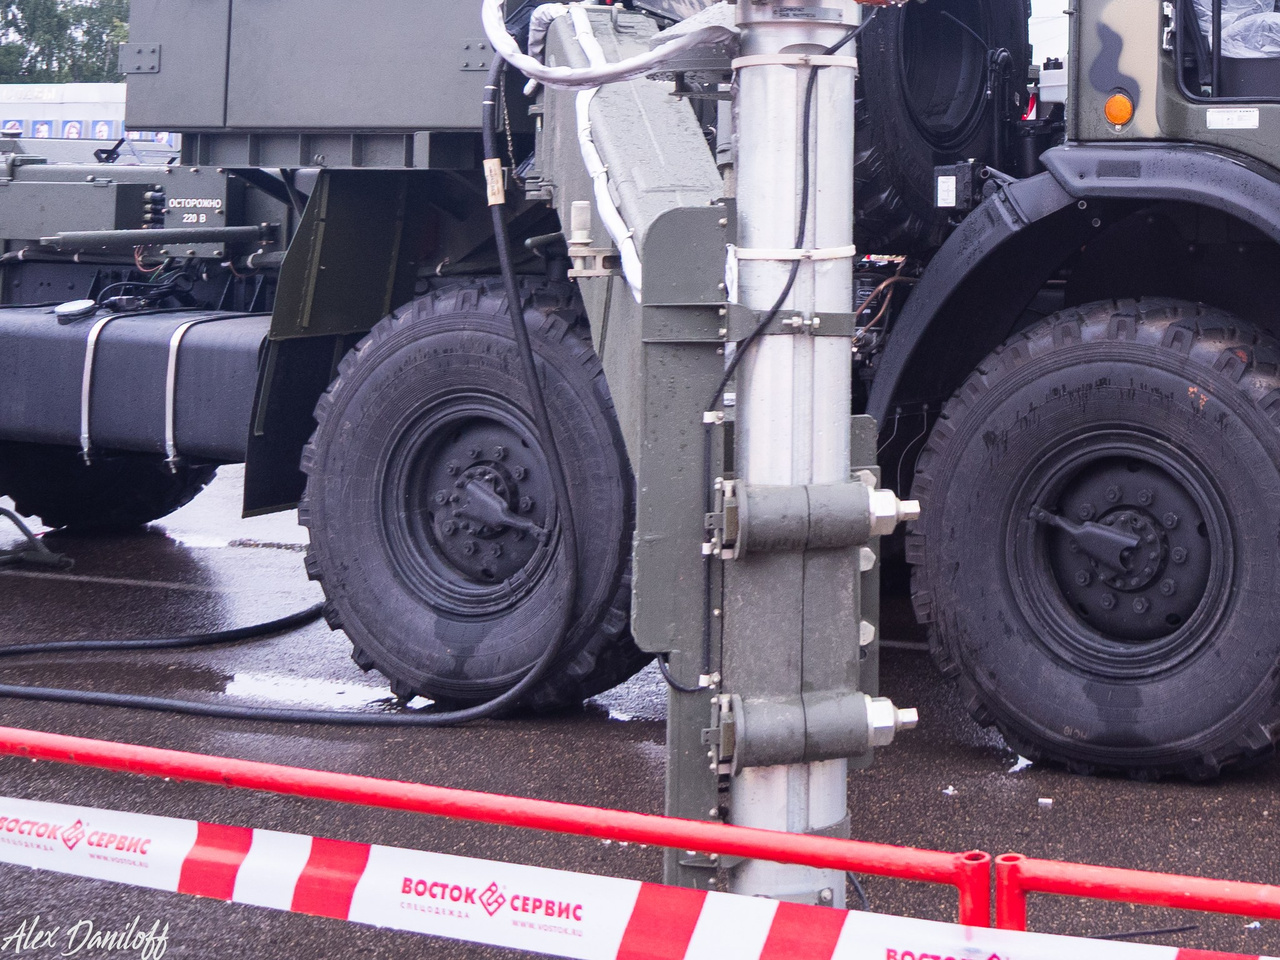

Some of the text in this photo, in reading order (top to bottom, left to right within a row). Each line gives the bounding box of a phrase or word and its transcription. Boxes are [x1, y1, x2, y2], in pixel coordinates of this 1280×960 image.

[168, 198, 222, 208] ОСТОРОЖНО
[182, 213, 207, 223] 220 В
[86, 830, 152, 855] СЕРВИС
[401, 876, 583, 922] ВОСТОК СЕРВИС
[400, 901, 470, 919] СПЕЦОДЕЖДА
